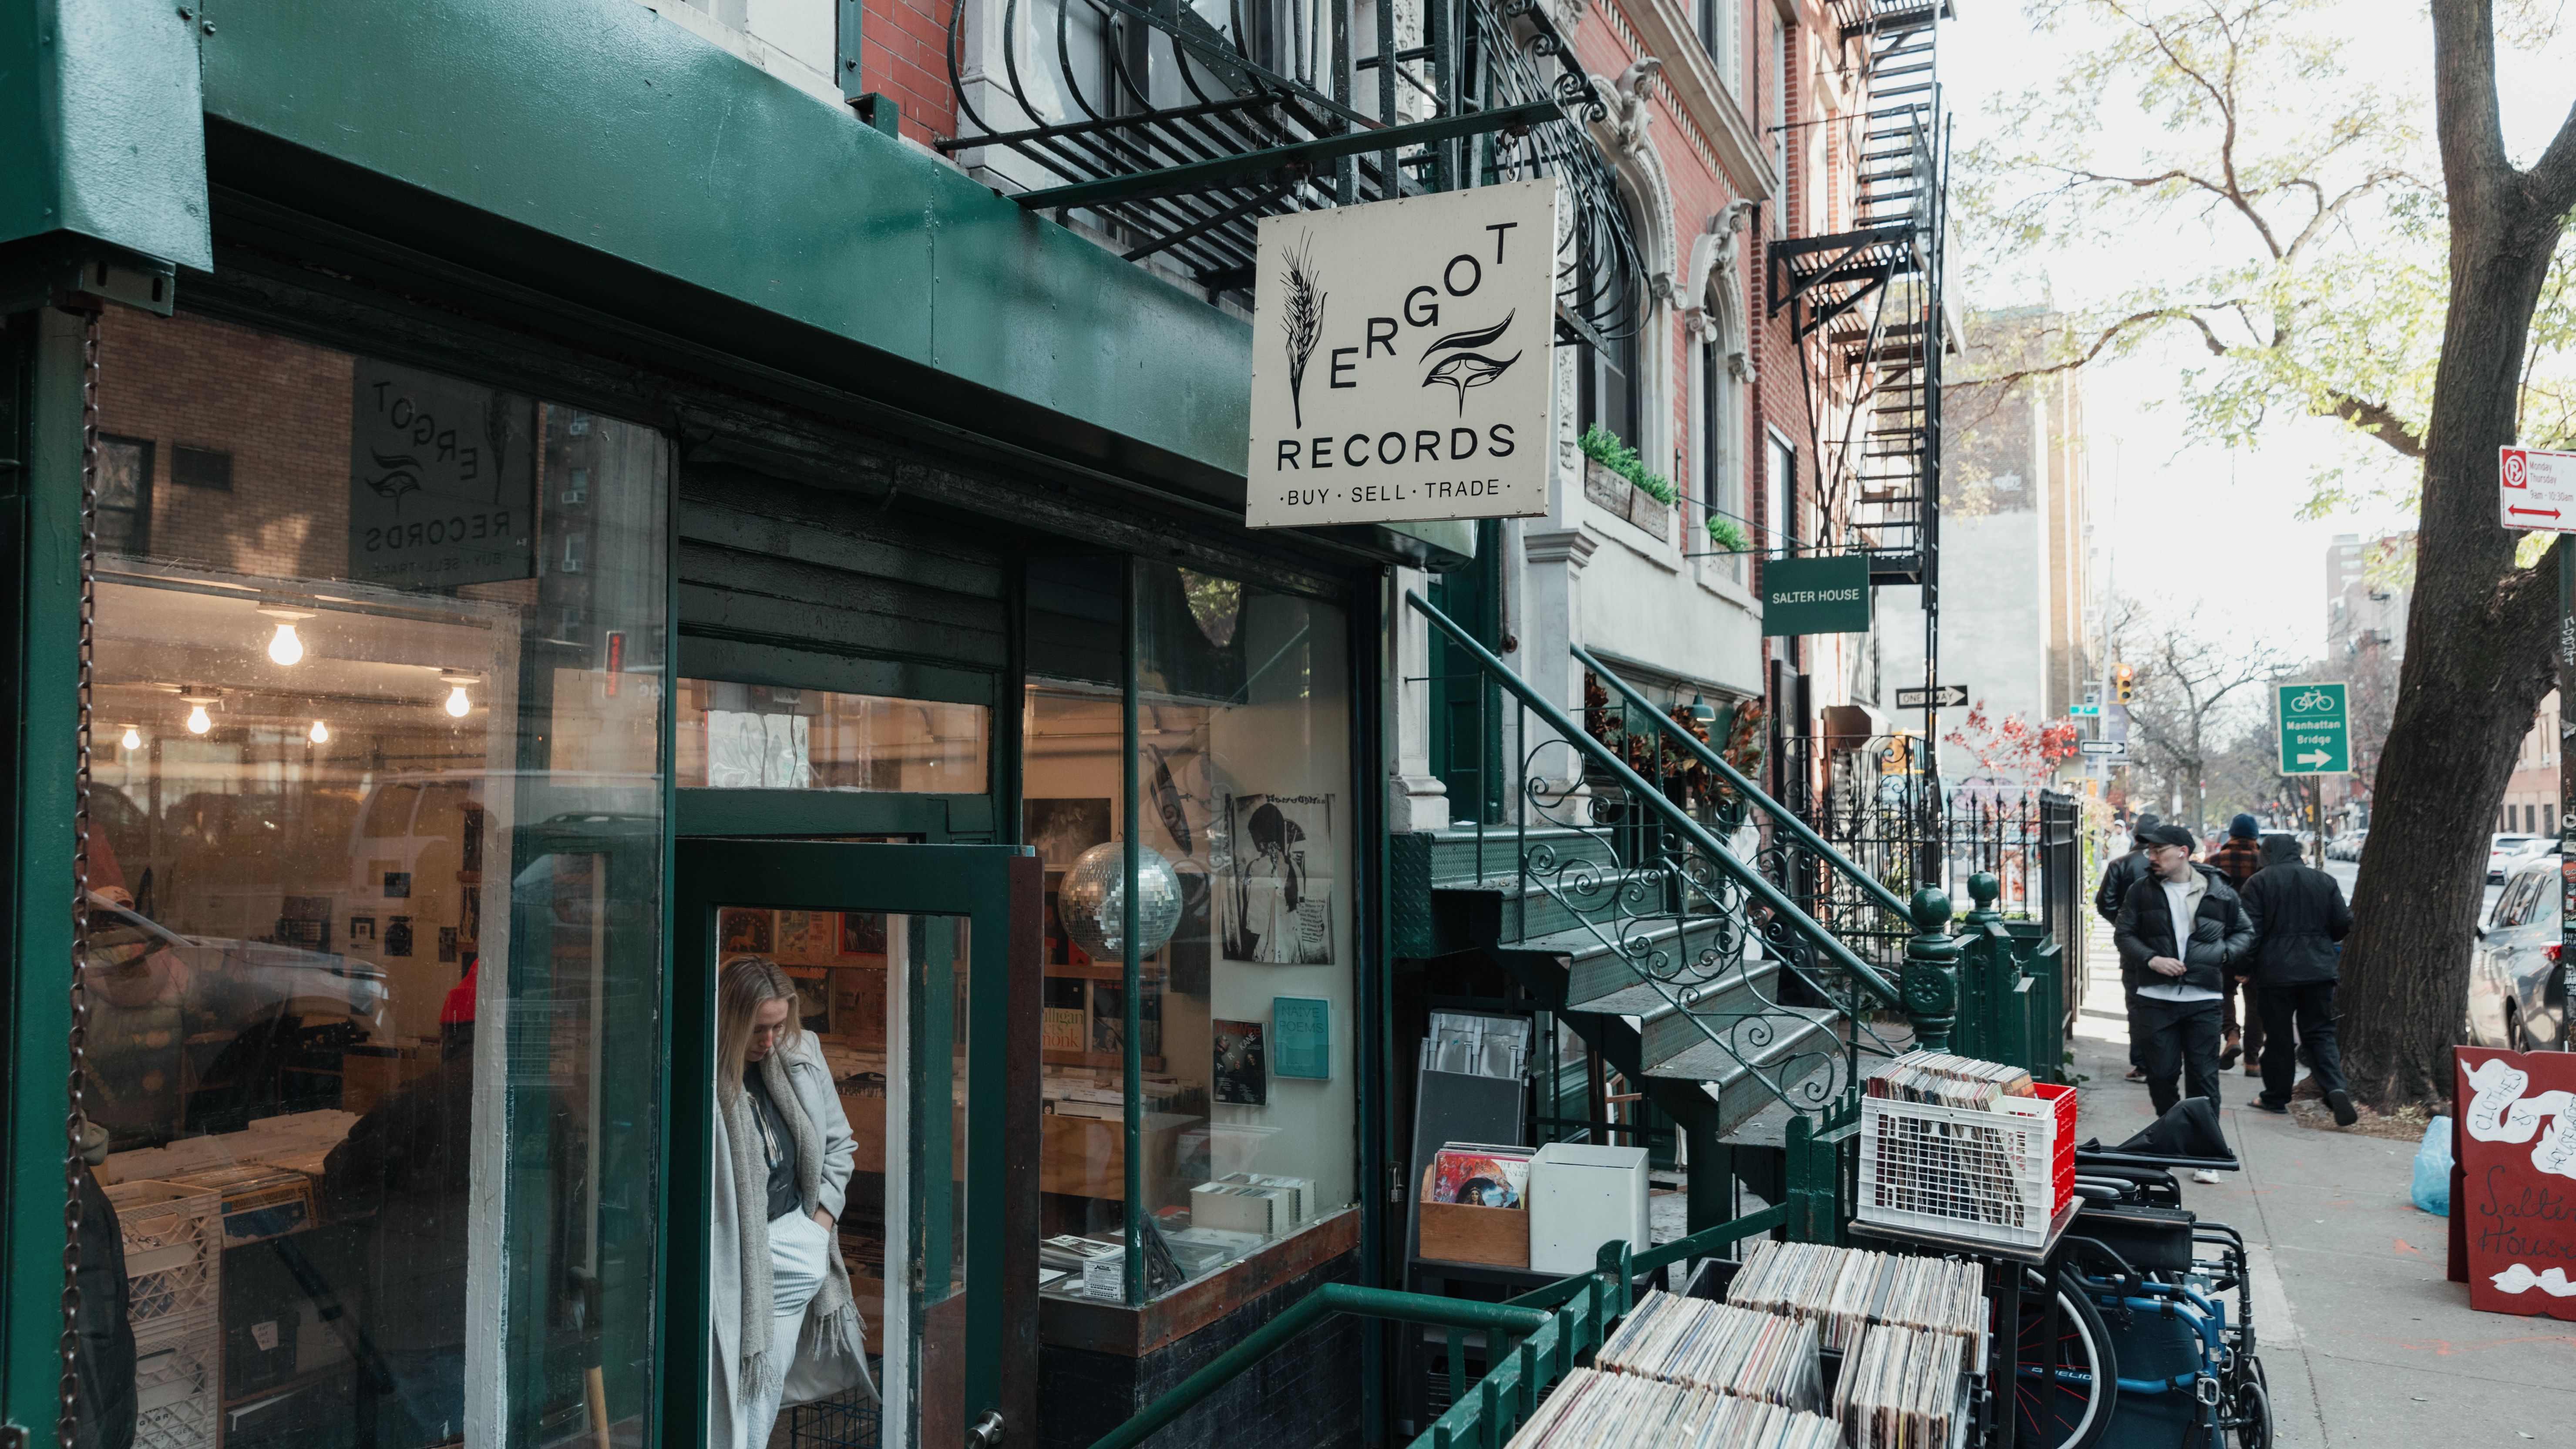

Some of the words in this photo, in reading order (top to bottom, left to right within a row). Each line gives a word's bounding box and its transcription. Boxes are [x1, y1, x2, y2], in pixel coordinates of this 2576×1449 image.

[1330, 222, 1517, 388] ERGOT
[1278, 424, 1515, 471] RECORDS
[2529, 461, 2552, 473] Monday
[2530, 473, 2557, 485] Thursday
[1352, 484, 1406, 502] SELL
[1425, 479, 1500, 498] TRADE
[2530, 490, 2543, 500] 9am
[2549, 491, 2573, 502] 10:30am
[1772, 591, 1816, 604] SALTER
[1819, 588, 1860, 602] HOUSE
[1903, 693, 1923, 703] ONE
[2286, 720, 2341, 730] Manhattan
[2297, 734, 2331, 746] Bridge
[1279, 1021, 1324, 1033] POEMS
[1238, 1032, 1257, 1051] KANE
[2475, 1067, 2522, 1130] CLOTHES
[2512, 1109, 2537, 1126] &
